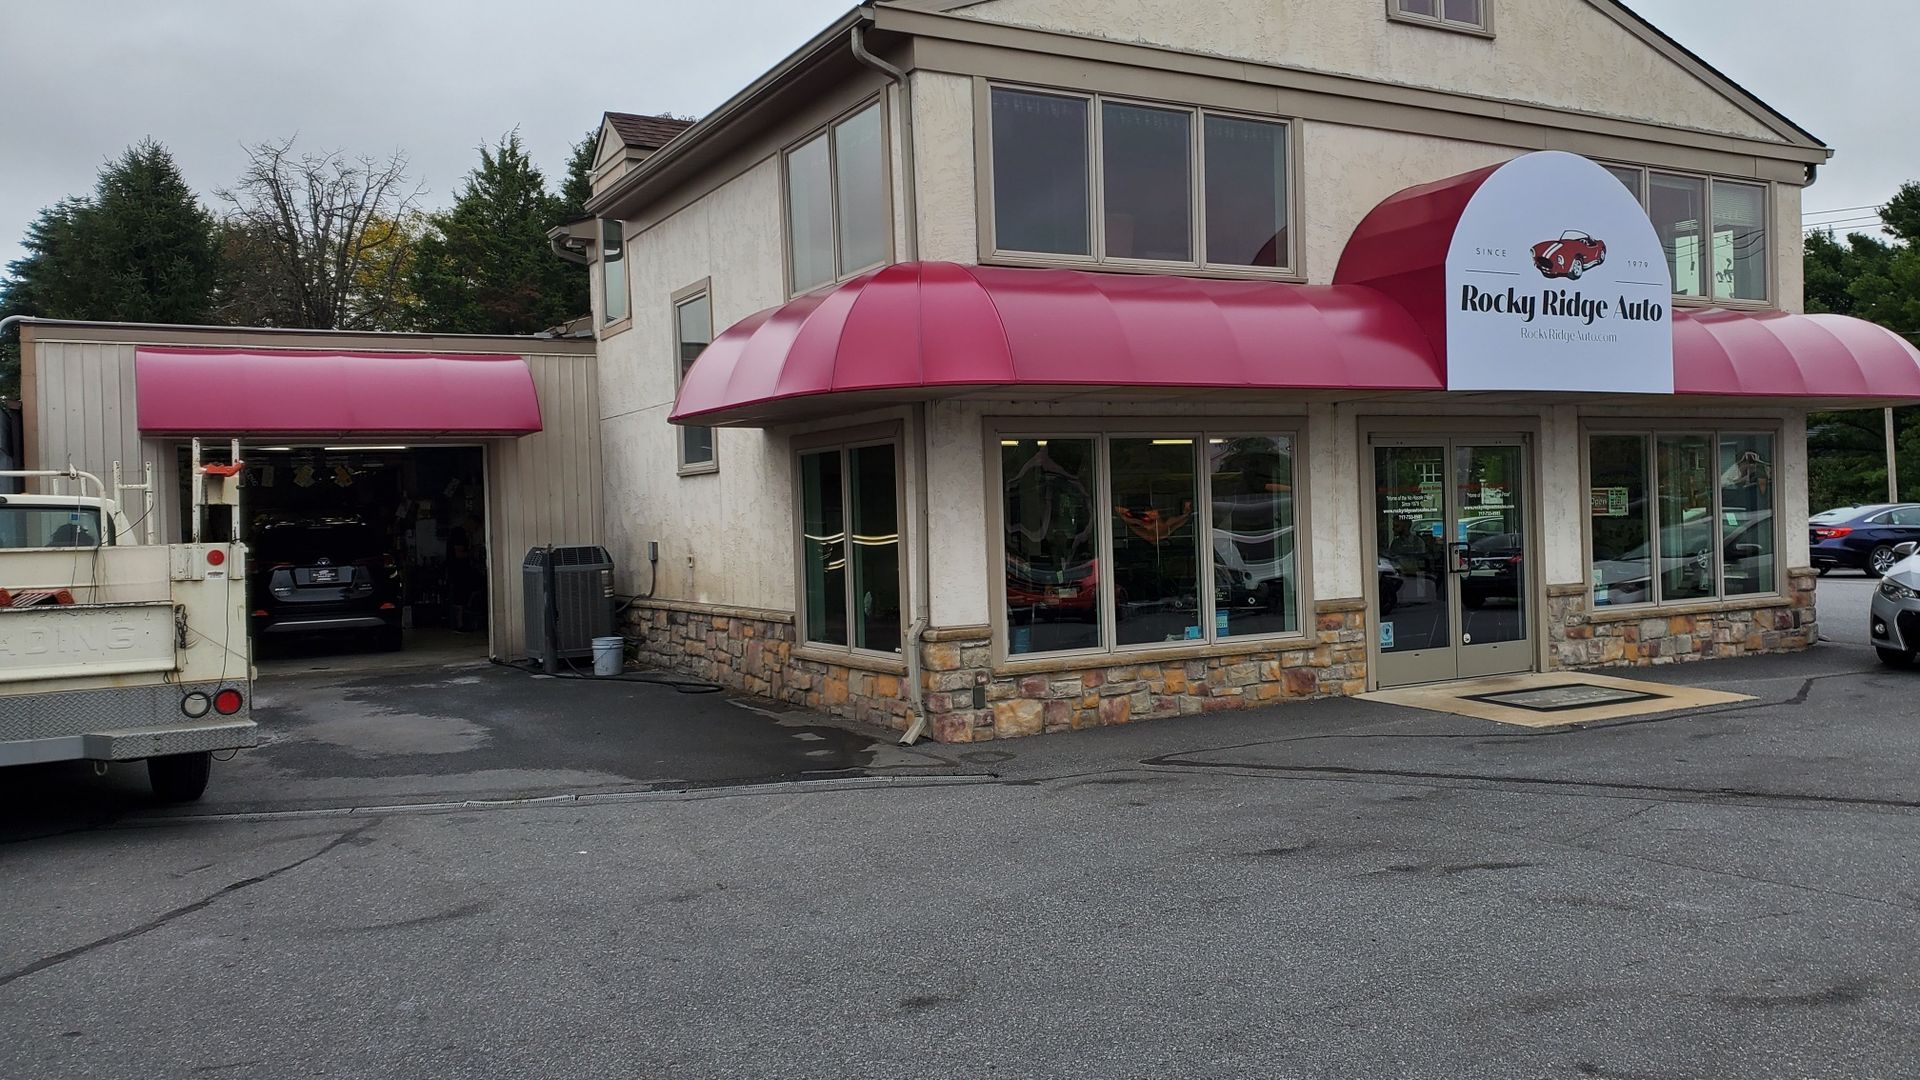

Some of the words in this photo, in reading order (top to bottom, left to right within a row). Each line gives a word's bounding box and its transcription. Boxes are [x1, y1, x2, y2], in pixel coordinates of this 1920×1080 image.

[1475, 247, 1507, 258] SINCE
[1627, 260, 1649, 269] 1979
[1461, 284, 1536, 323] Rocky
[1542, 288, 1609, 326] Ridge
[1612, 294, 1663, 322] Auto
